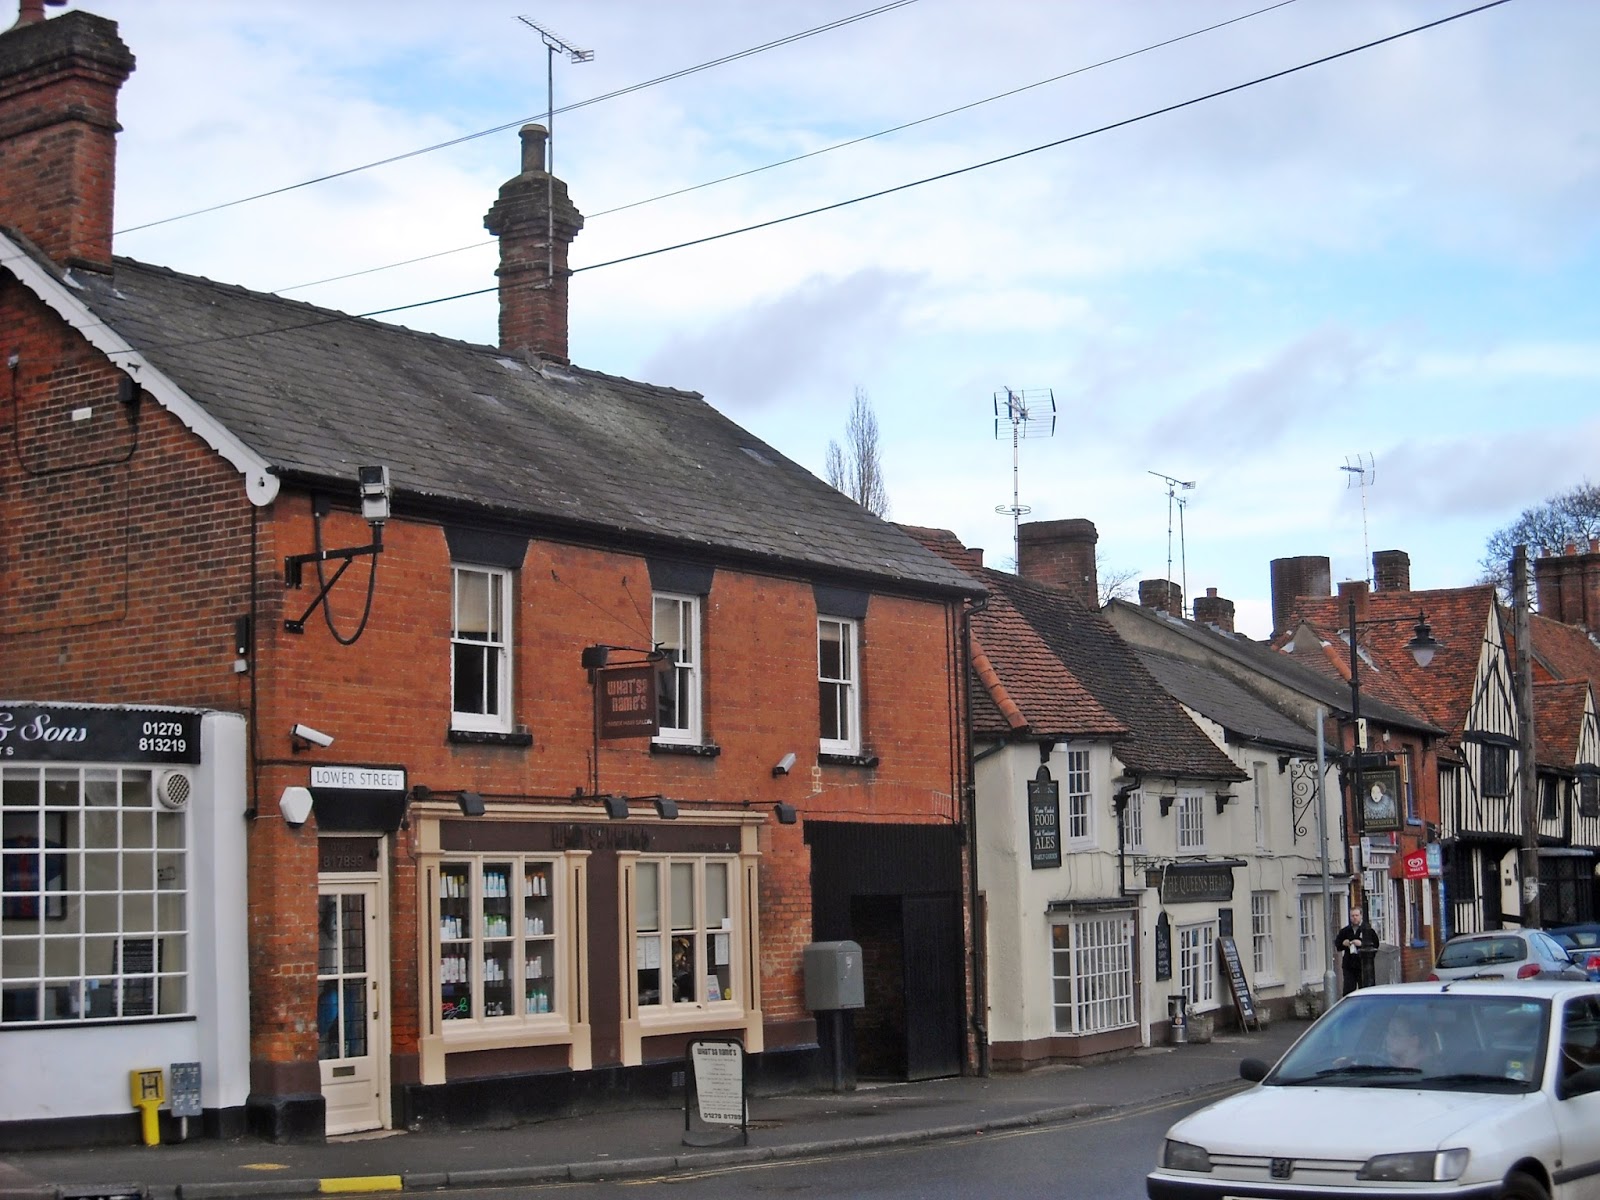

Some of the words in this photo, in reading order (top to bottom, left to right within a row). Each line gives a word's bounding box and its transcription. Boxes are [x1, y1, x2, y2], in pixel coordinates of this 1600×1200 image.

[20, 713, 87, 743] Sons
[142, 721, 183, 736] 01279
[138, 738, 187, 753] 813219
[316, 770, 355, 785] LOWER
[360, 772, 400, 786] STREET
[1034, 813, 1055, 826] FOOD
[1034, 836, 1055, 850] ALES
[1209, 874, 1228, 892] HEAD
